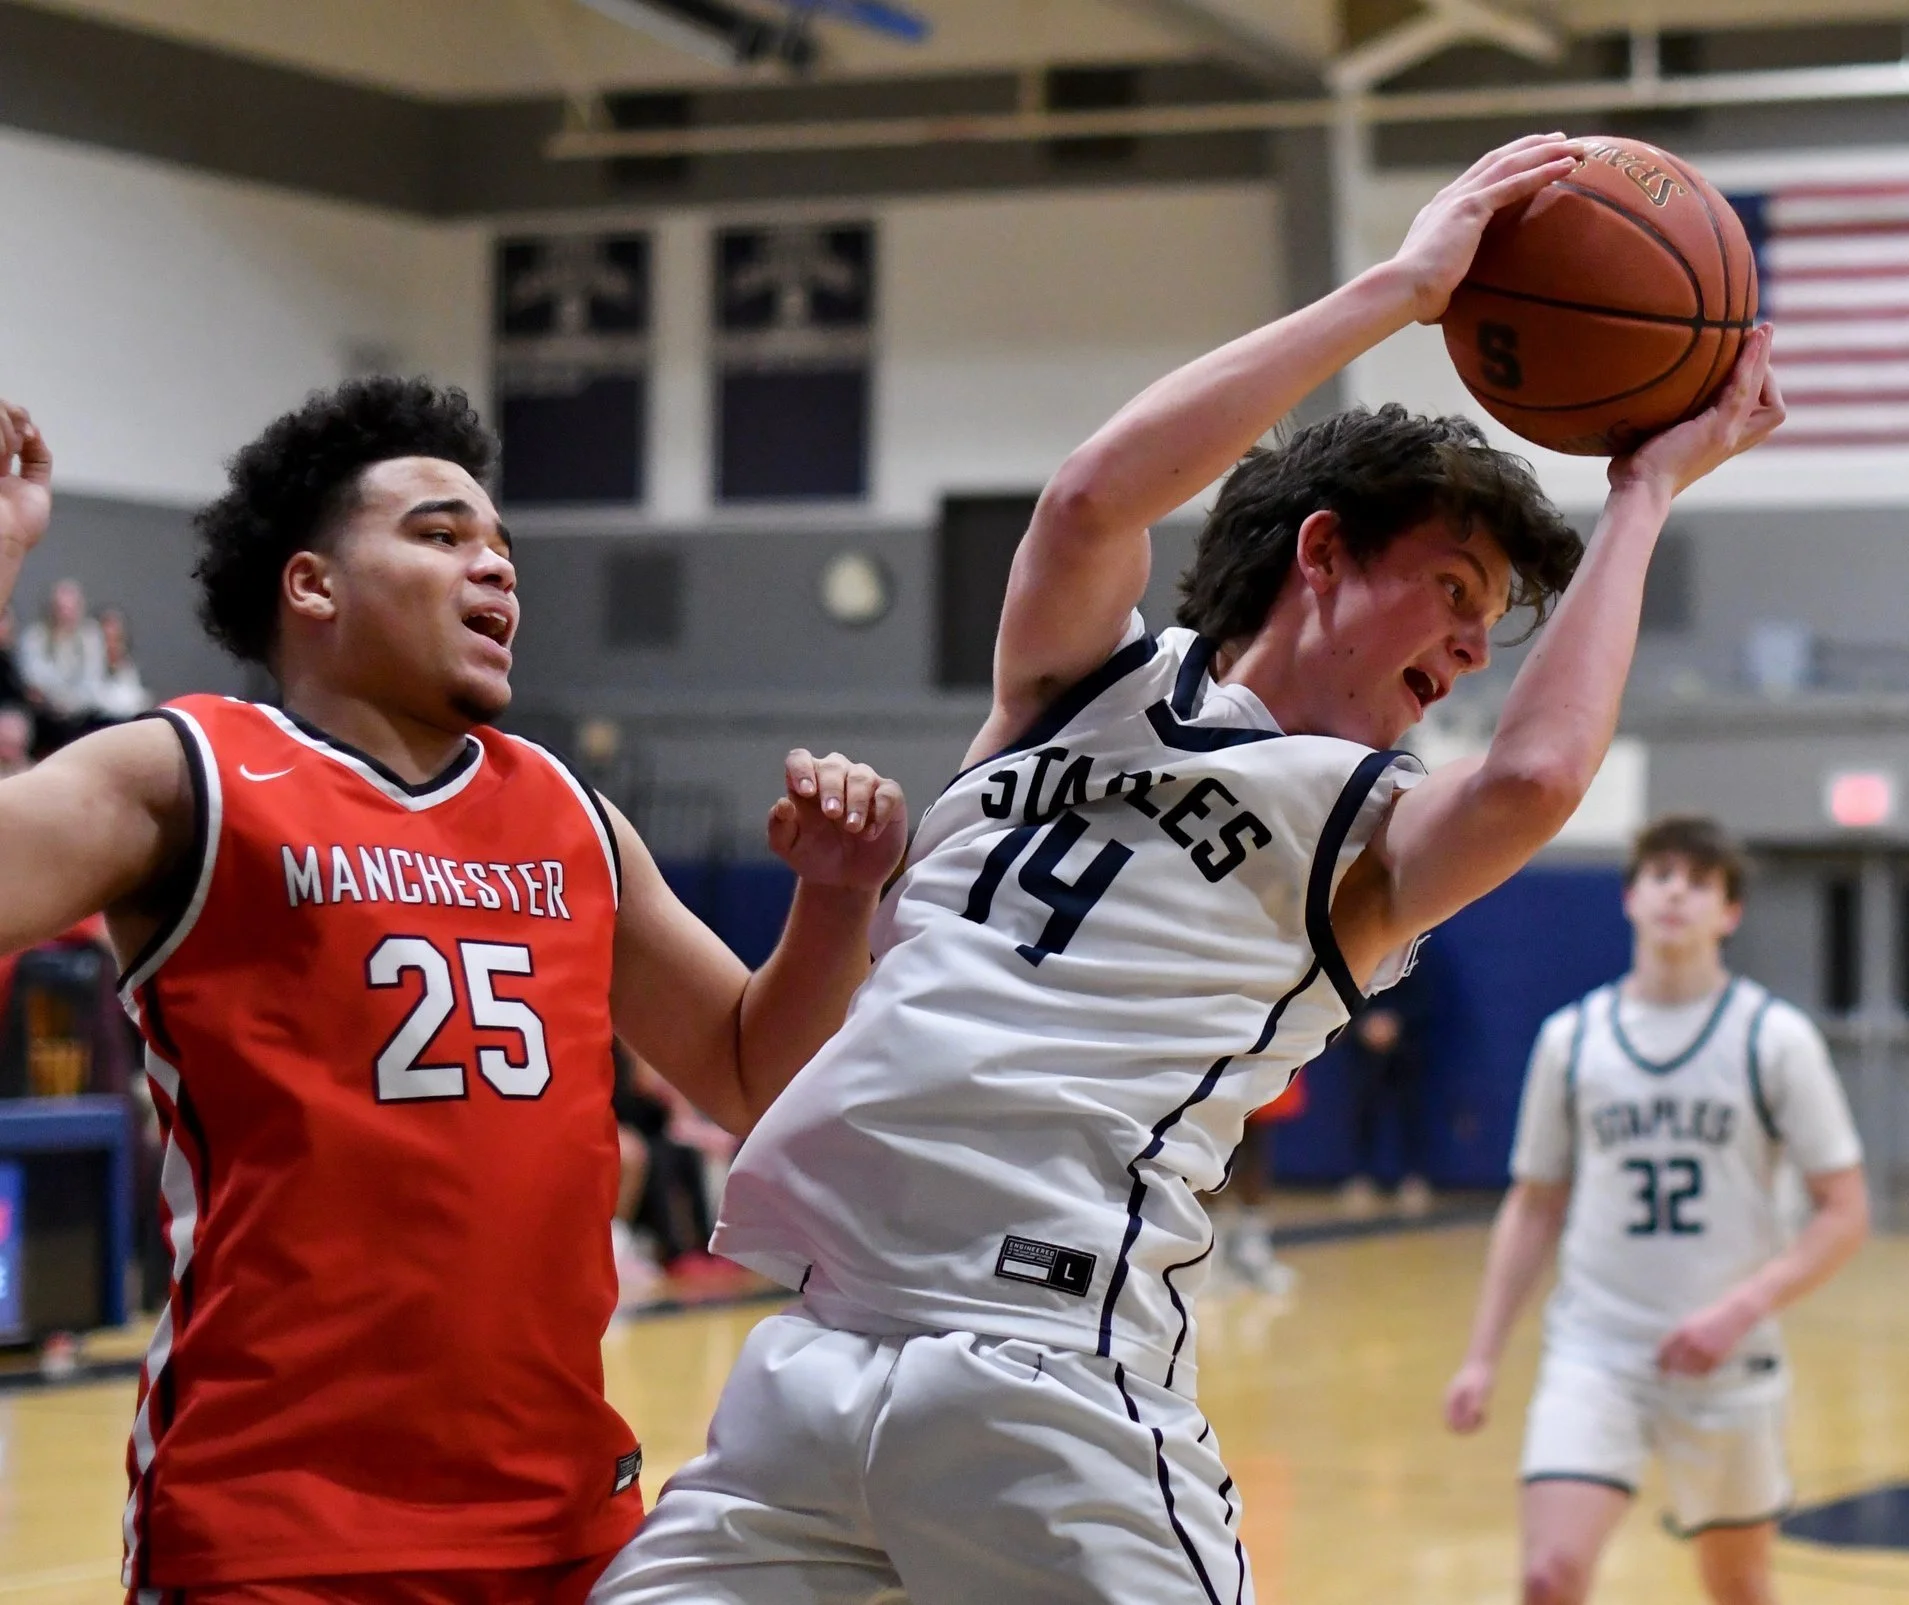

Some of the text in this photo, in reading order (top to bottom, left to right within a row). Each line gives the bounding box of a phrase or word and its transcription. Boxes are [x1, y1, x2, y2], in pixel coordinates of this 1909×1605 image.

[1476, 322, 1523, 391] S
[282, 844, 571, 920] MANCHESTER
[961, 810, 1135, 967] 14
[365, 934, 552, 1105] 25
[1623, 1157, 1706, 1236] 32
[1009, 1242, 1055, 1257] ENGINEERED
[1064, 1263, 1075, 1280] L
